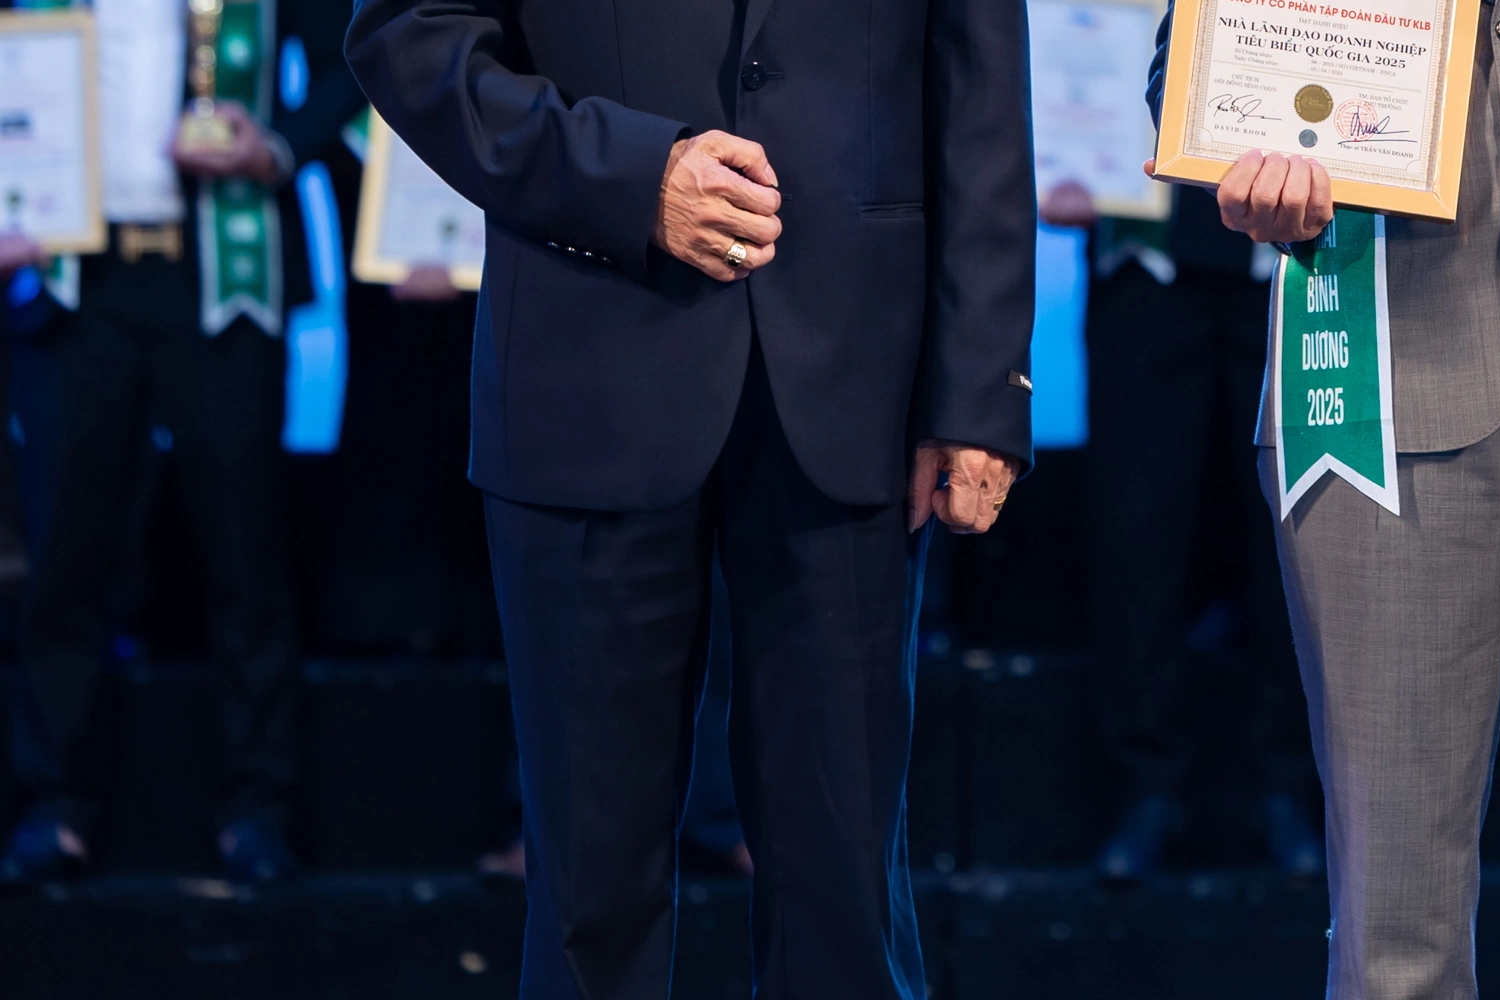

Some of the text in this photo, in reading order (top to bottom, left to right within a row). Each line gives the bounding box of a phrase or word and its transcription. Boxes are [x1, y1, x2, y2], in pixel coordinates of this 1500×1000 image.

[1288, 0, 1317, 14] PHẦN
[1320, 5, 1338, 17] TẬP
[1341, 9, 1371, 21] ĐOÀN
[1374, 12, 1396, 25] ĐẦU
[1398, 18, 1412, 27] TƯ
[1413, 20, 1431, 30] KLB
[1218, 17, 1426, 57] NHÀ LÃNH ĐẠO DOANH NGHIỆP
[1236, 35, 1406, 69] TIÊU BIỂU QUỐC GIA 2025
[1214, 124, 1240, 132] DAVID
[1307, 268, 1339, 313] BÌNH
[1302, 330, 1349, 371] DƯƠNG
[1307, 387, 1344, 426] 2025
